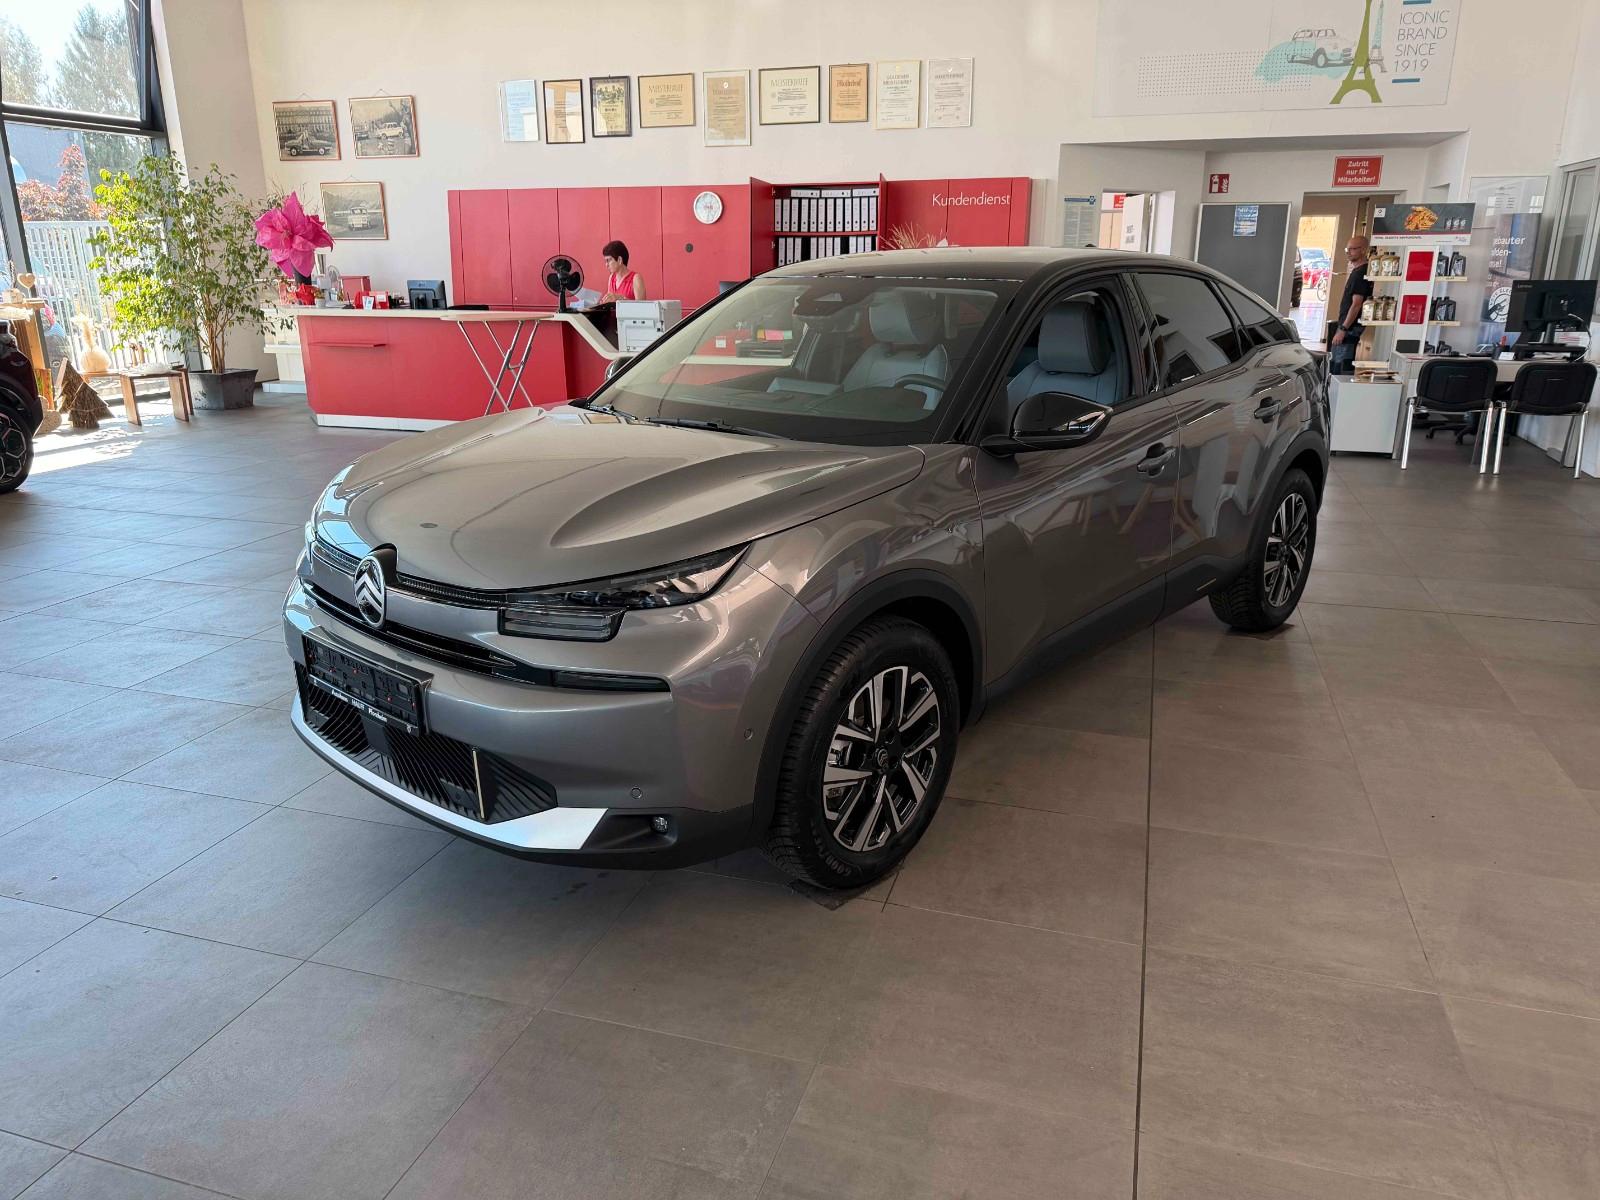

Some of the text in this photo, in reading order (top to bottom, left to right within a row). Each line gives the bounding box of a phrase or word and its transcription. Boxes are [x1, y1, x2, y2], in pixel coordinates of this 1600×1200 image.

[1400, 9, 1451, 25] ICONIC
[1397, 26, 1448, 41] BRAND
[1394, 42, 1438, 57] SINCE
[1394, 58, 1429, 72] 1919
[1347, 160, 1369, 168] Zutritt
[1337, 175, 1376, 183] Mitarbeiter!
[932, 191, 1010, 207] Kundendienst
